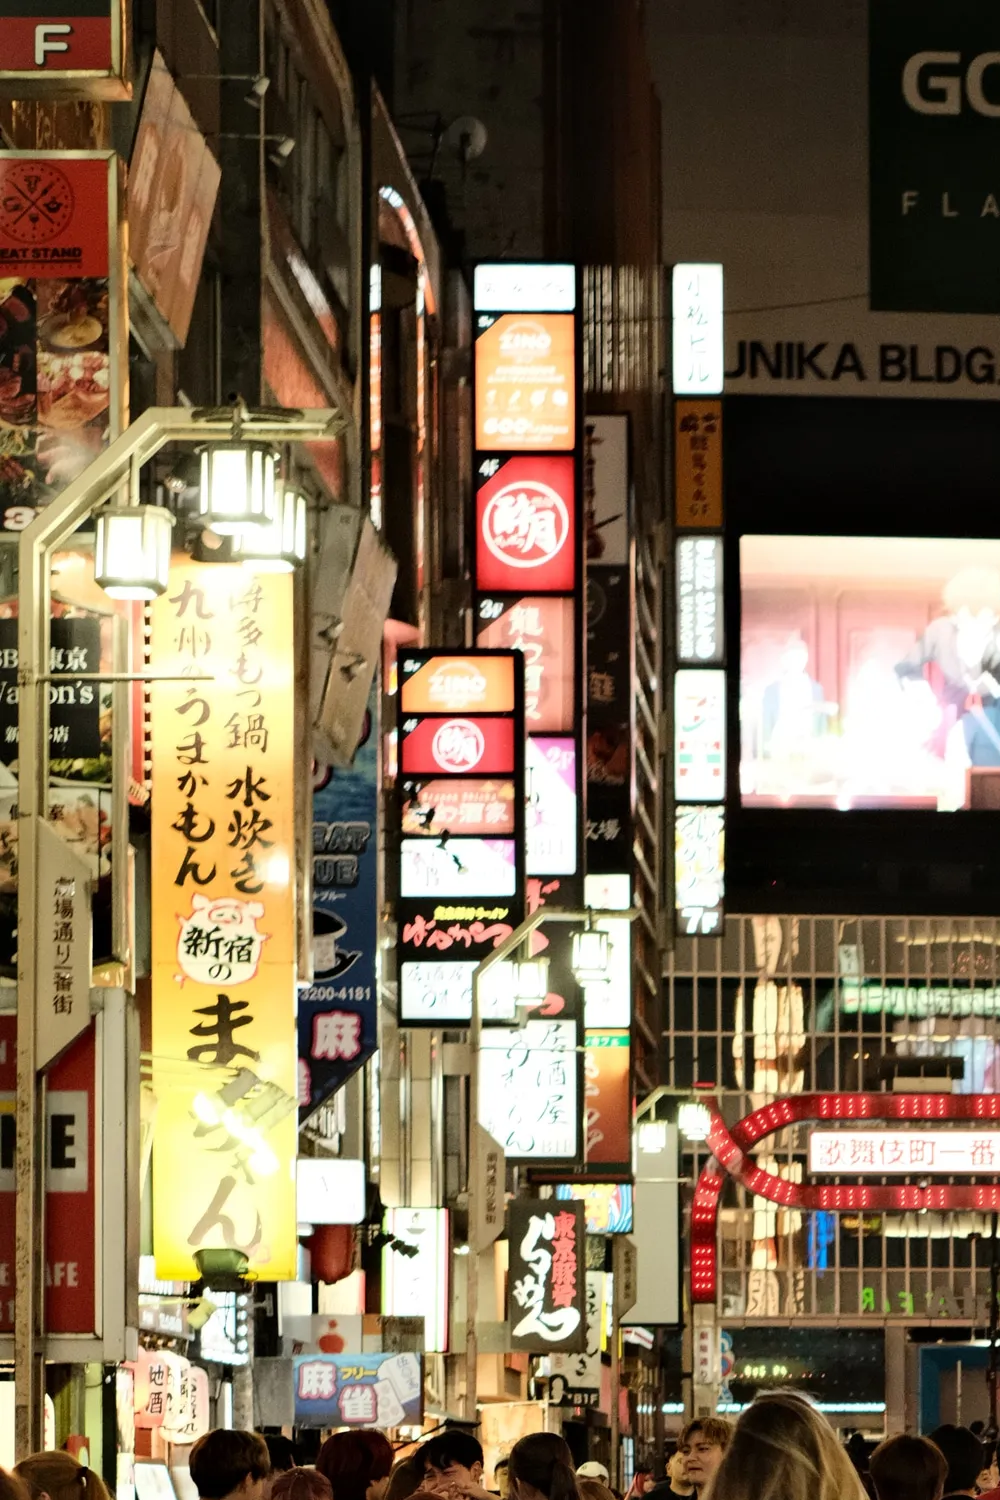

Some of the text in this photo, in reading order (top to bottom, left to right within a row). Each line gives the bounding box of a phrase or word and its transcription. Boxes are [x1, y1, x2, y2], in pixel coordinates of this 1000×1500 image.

[35, 25, 71, 65] F
[32, 248, 82, 258] STAND
[428, 675, 486, 692] ZINO
[225, 765, 277, 895] 水炊き
[682, 907, 720, 933] 7F
[52, 876, 76, 1016] 劇場通り一番街
[182, 924, 257, 964] 新宿
[208, 958, 232, 982] の
[537, 1022, 569, 1125] 居酒屋
[149, 1364, 164, 1414] 地酒
[341, 1366, 378, 1381] フリー
